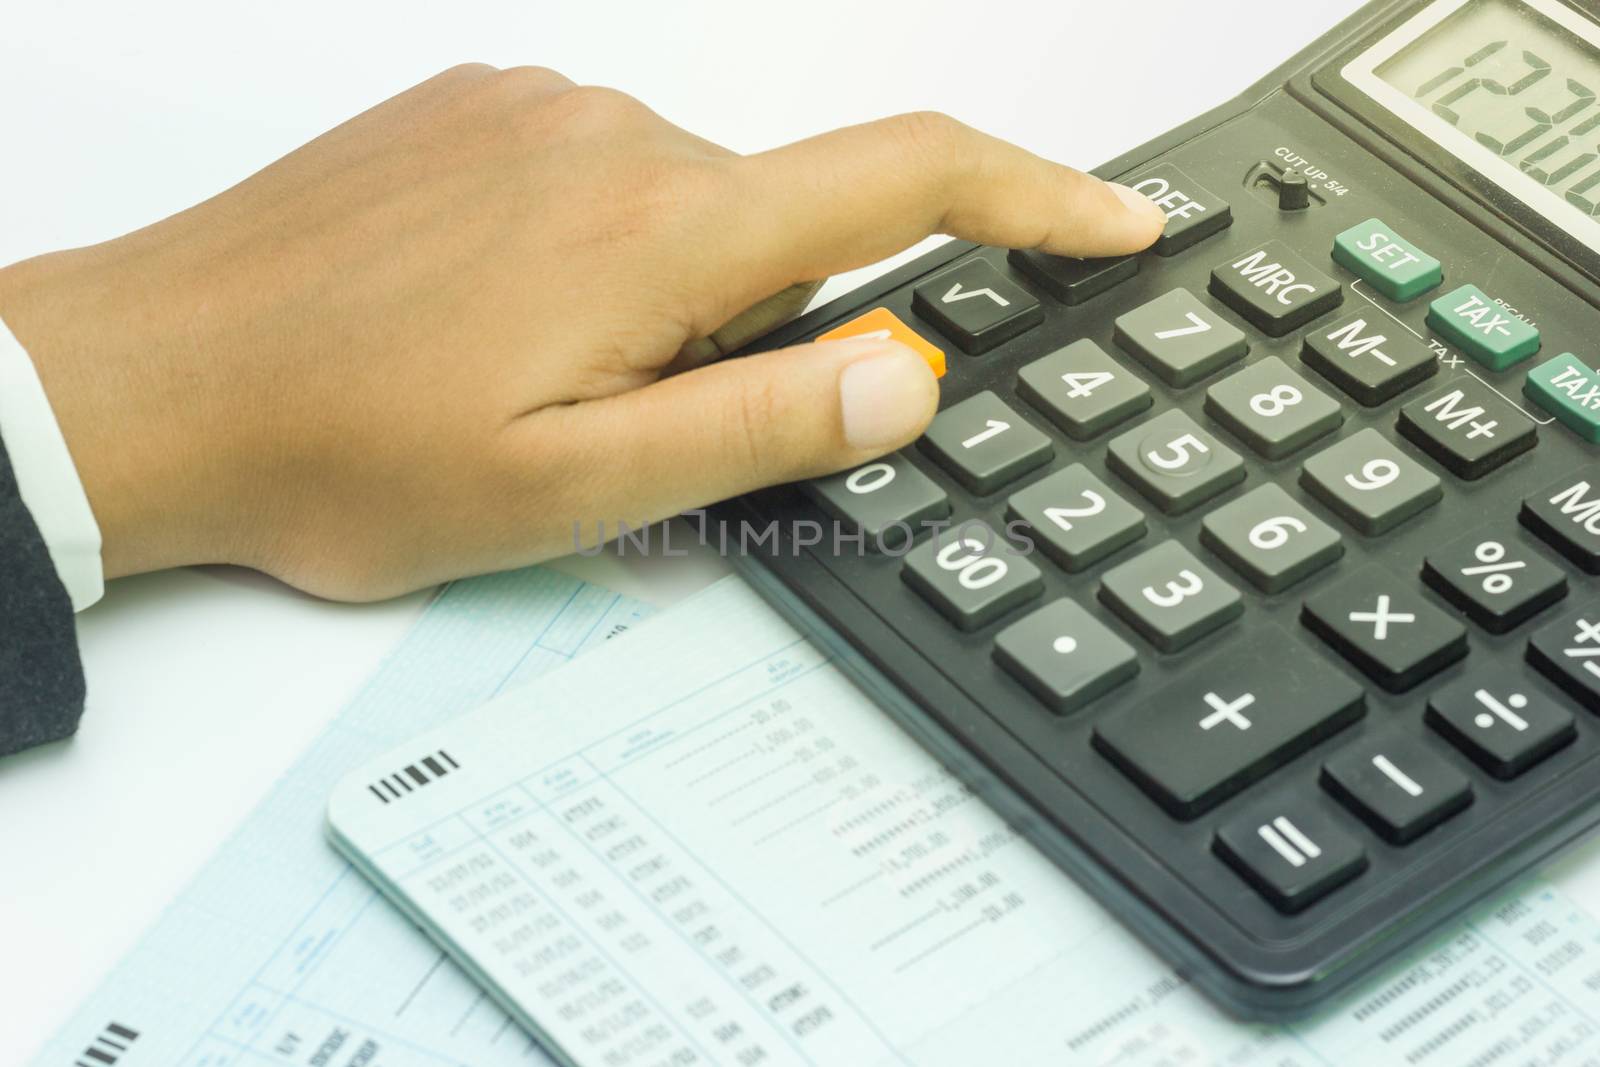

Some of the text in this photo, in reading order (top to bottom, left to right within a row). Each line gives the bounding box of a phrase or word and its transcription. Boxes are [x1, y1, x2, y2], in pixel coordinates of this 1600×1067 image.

[1274, 147, 1349, 197] CUT UP 5/4
[1132, 178, 1206, 219] OFF
[1356, 232, 1421, 270] SET
[1231, 250, 1316, 305] MRC
[1154, 311, 1212, 340] 7
[1427, 338, 1465, 370] TAX
[1061, 371, 1115, 398] 4
[1249, 384, 1303, 417] 8
[1424, 389, 1498, 440] M+
[962, 419, 1011, 449] 1
[1147, 433, 1209, 469] 5
[845, 464, 896, 494] 0
[1344, 458, 1400, 490] 9
[1043, 489, 1106, 531] 2
[1248, 516, 1307, 549] 6
[936, 538, 1008, 589] 00
[1461, 541, 1526, 594] %
[1142, 569, 1203, 607] 3
